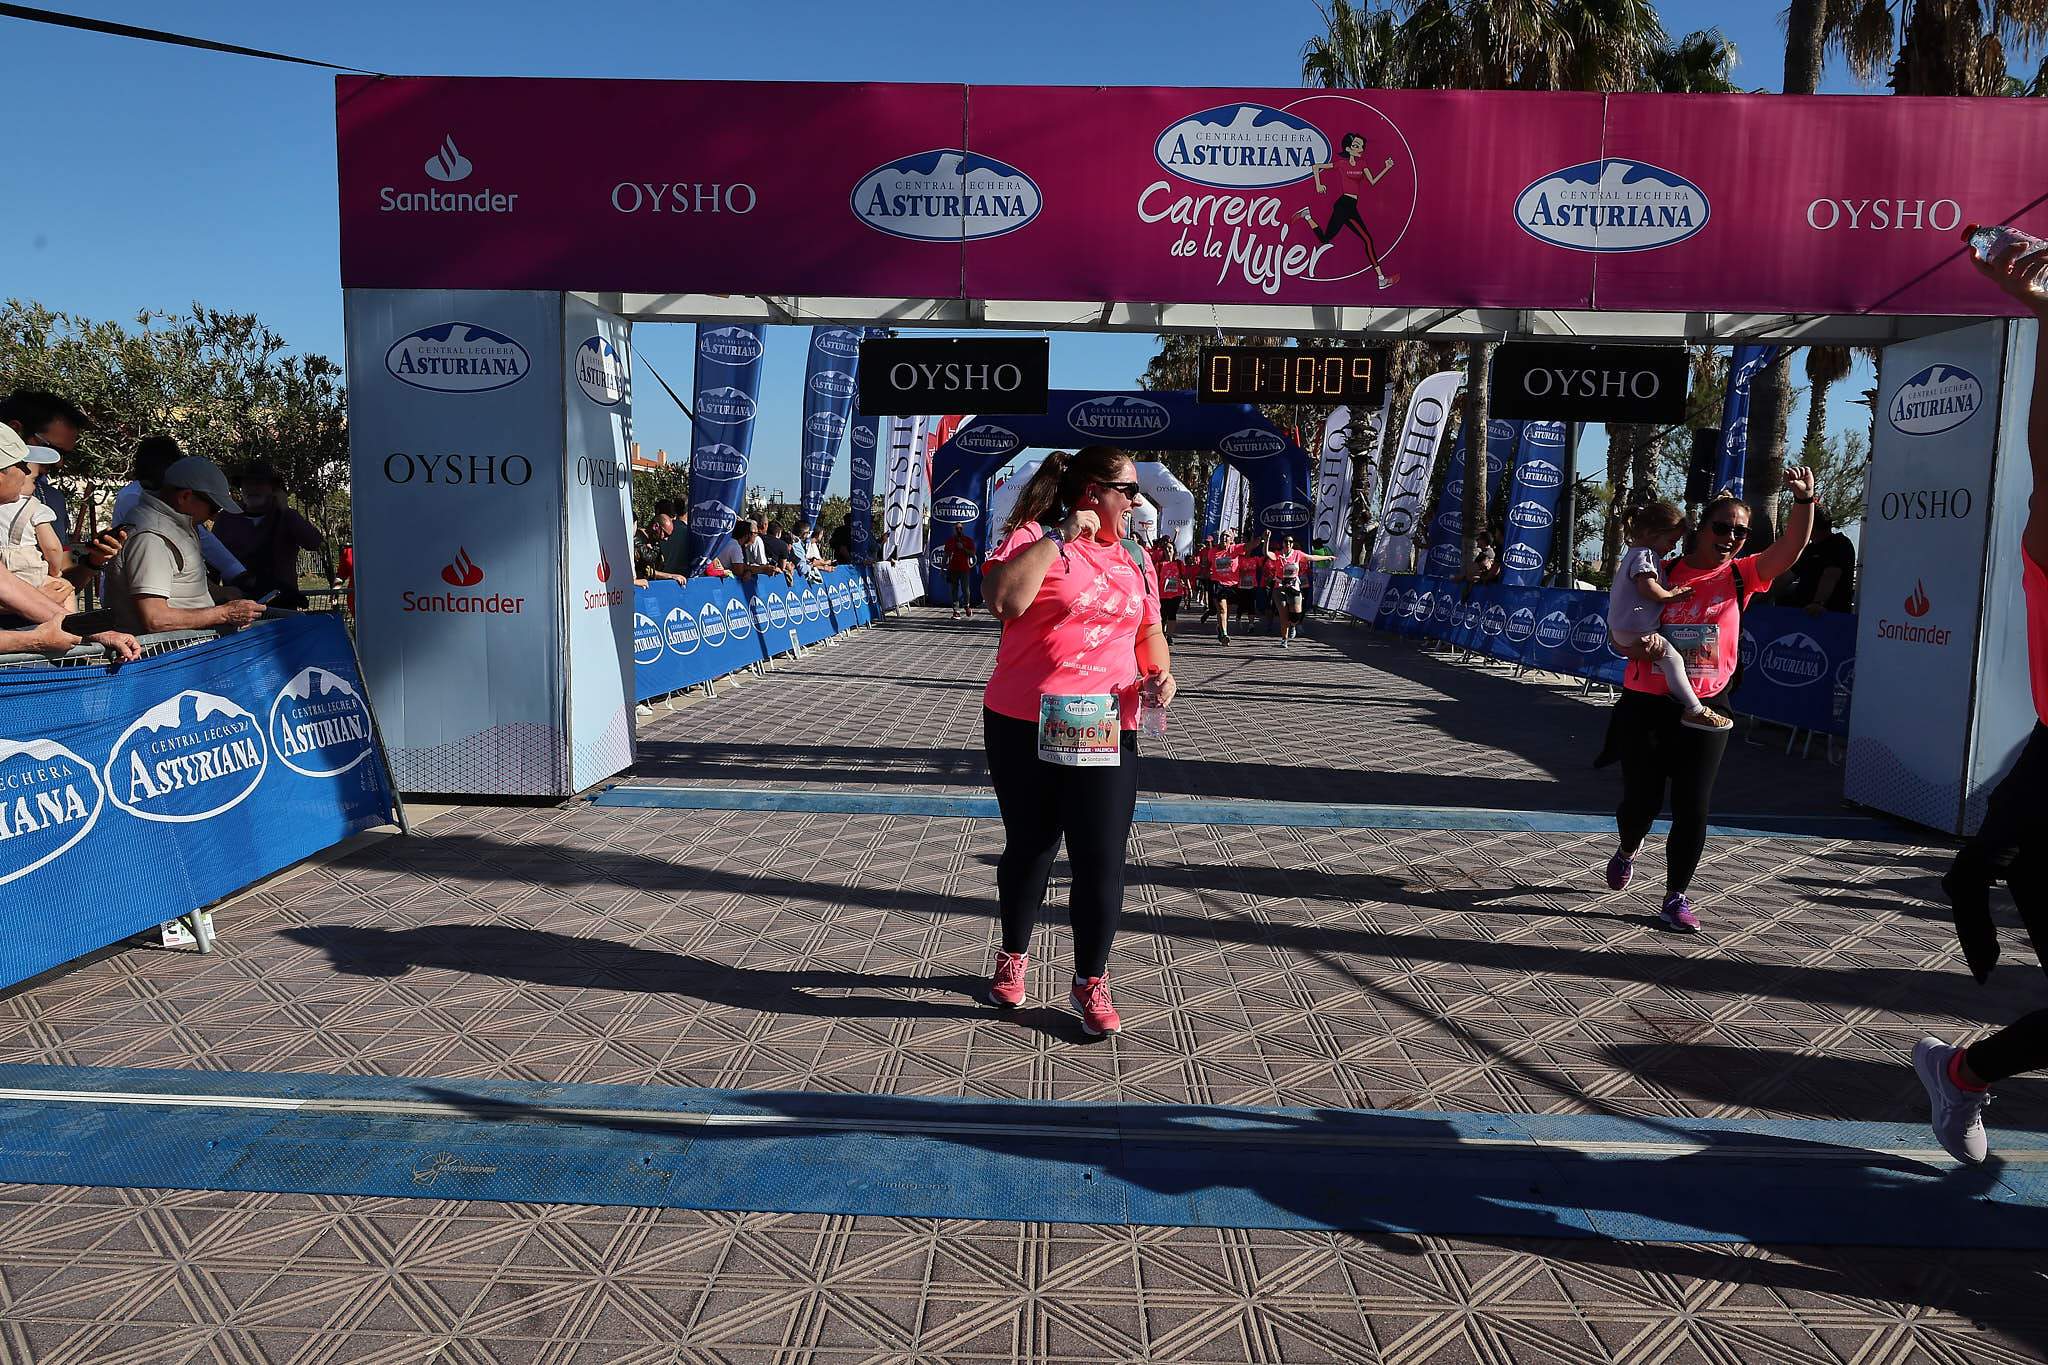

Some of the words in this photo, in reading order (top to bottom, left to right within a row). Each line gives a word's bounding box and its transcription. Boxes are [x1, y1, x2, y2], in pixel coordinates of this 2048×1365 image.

[1168, 133, 1317, 167] ASTURIANA
[1196, 132, 1251, 141] CENTRAL
[1257, 133, 1313, 142] LECHERA
[611, 182, 757, 215] OYSHO
[895, 181, 954, 190] CENTRAL
[1560, 190, 1622, 201] CENTRAL
[1626, 191, 1689, 201] LECHERA
[380, 187, 518, 214] Santander
[866, 183, 1027, 217] ASTURIANA
[1137, 180, 1282, 228] Carrera
[1529, 192, 1694, 228] ASTURIANA
[1806, 198, 1962, 232] OYSHO
[1170, 228, 1198, 257] de
[1203, 228, 1223, 258] la
[1217, 225, 1334, 294] Mujer
[418, 346, 466, 355] CENTRAL
[468, 347, 515, 355] LECHERA
[702, 337, 757, 357] ASTURIANA
[398, 348, 519, 376] ASTURIANA
[1212, 356, 1372, 394] 01:10:09
[890, 362, 1022, 392] OYSHO
[1524, 367, 1661, 399] OYSHO
[1076, 407, 1163, 429] ASTURIANA
[1893, 393, 1975, 423] ASTURIANA
[960, 434, 1014, 448] ASTURIANA
[1225, 440, 1281, 452] ASTURIANA
[383, 452, 533, 486] OYSHO
[578, 455, 626, 490] OYSHO
[1384, 397, 1444, 537] OYSHO
[1521, 468, 1559, 485] ASTURIANA
[1317, 428, 1349, 544] OYSHO
[933, 507, 976, 518] ASTURIANA
[1263, 511, 1307, 523] ASTURIANA
[1881, 488, 1972, 521] OYSHO
[402, 591, 525, 614] Santander
[584, 588, 624, 611] Santander
[667, 627, 699, 645] ASTURIANA
[1878, 618, 1952, 647] Santander
[1764, 652, 1819, 677] ASTURIANA
[292, 703, 326, 720] CENTRAL
[151, 732, 201, 754] CENTRAL
[281, 714, 367, 757] ASTURIAN
[0, 764, 73, 791] ECHERA
[127, 736, 262, 804] ASTURIANA
